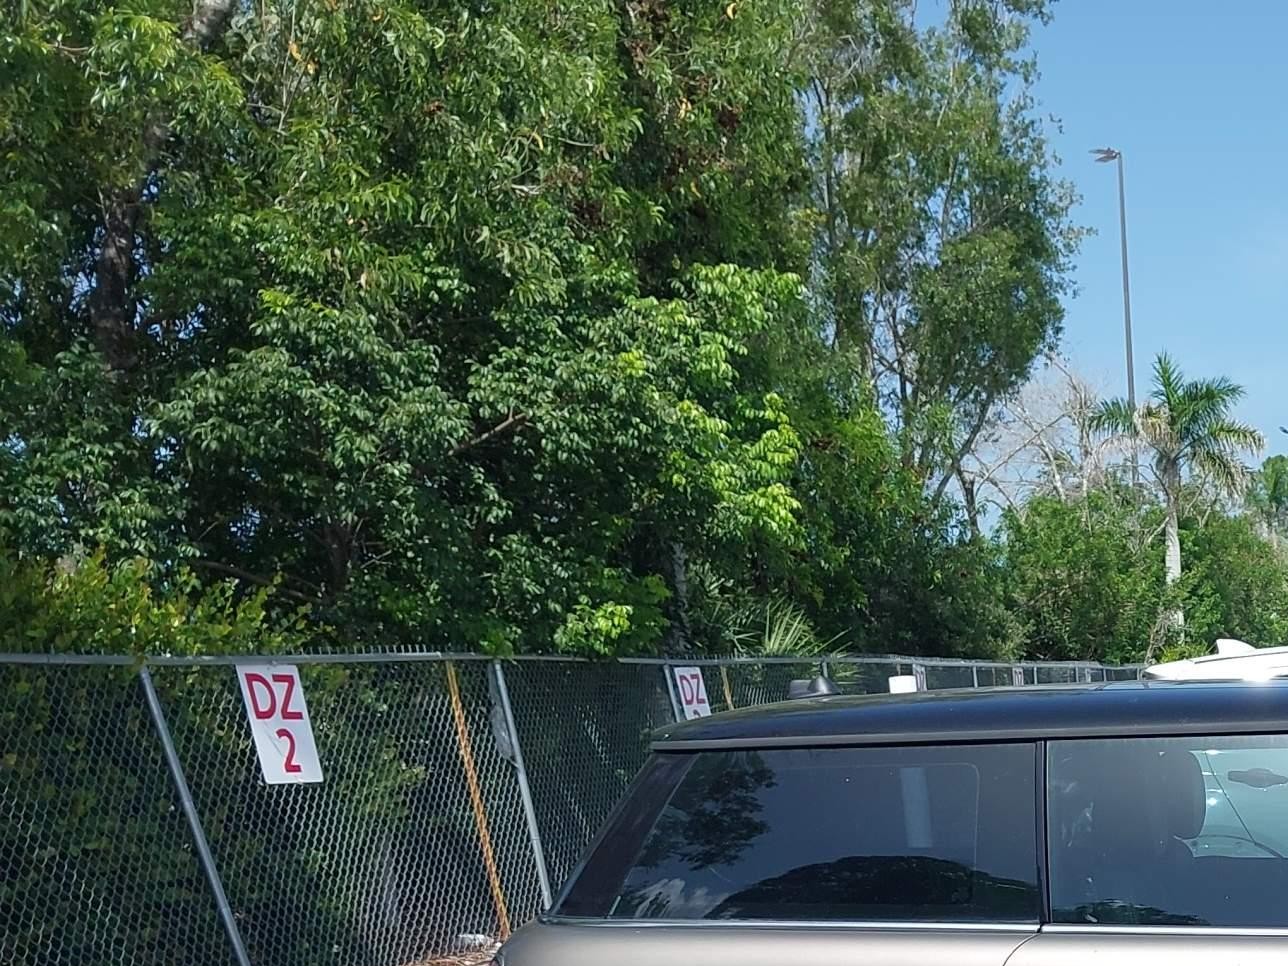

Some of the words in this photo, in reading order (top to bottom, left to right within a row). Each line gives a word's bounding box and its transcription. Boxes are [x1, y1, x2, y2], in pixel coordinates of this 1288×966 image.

[244, 672, 305, 720] DZ
[679, 673, 706, 705] DZ
[275, 727, 303, 773] 2
